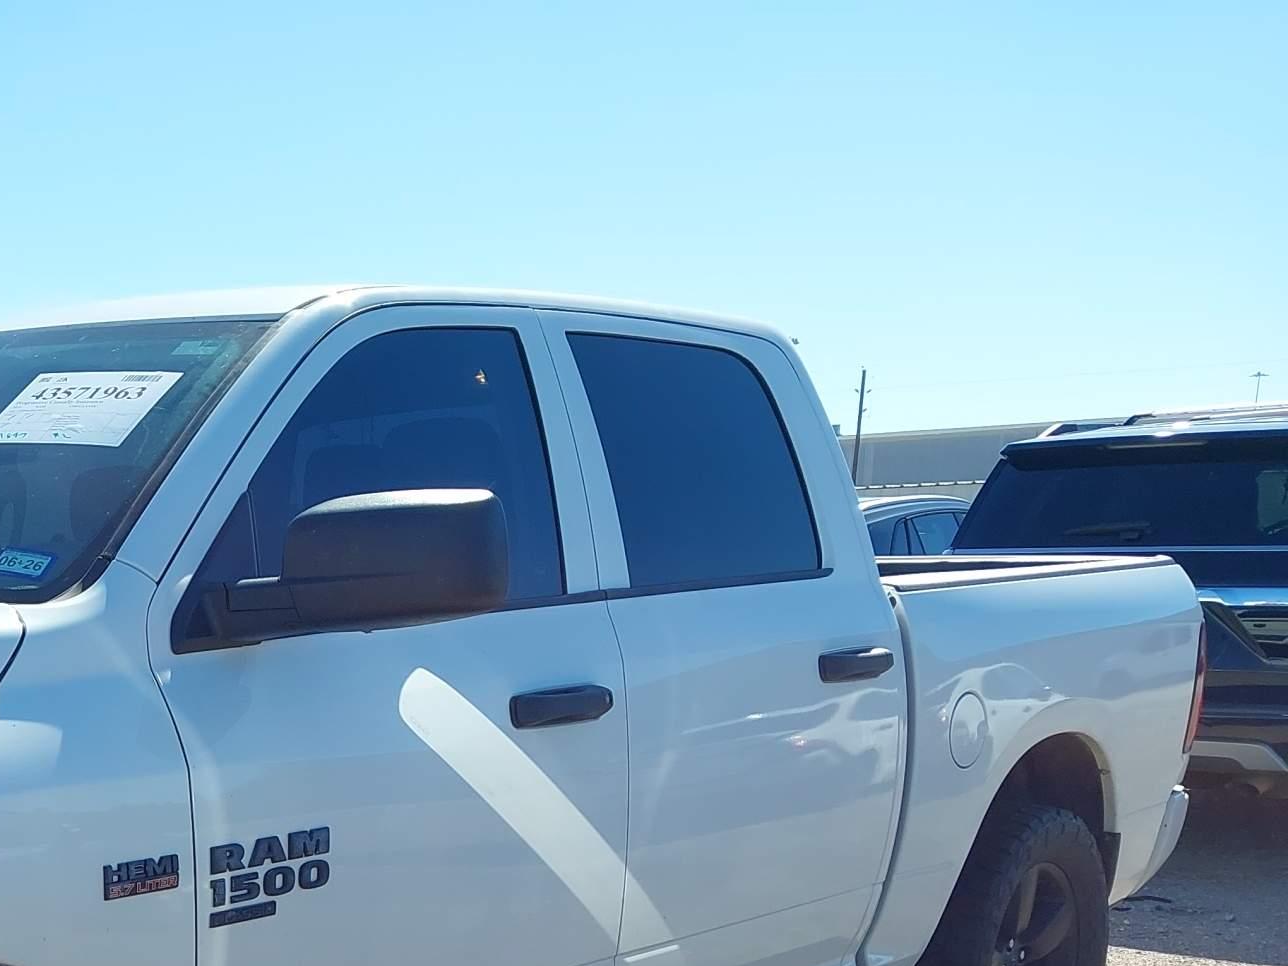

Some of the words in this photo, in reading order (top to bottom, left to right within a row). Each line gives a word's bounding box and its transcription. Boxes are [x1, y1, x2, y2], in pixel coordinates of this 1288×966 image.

[32, 386, 148, 400] 43571963
[209, 826, 330, 875] RAM
[103, 854, 179, 884] HEMI
[210, 859, 330, 908] 1500
[109, 881, 134, 898] 5.7
[136, 875, 179, 894] LITER
